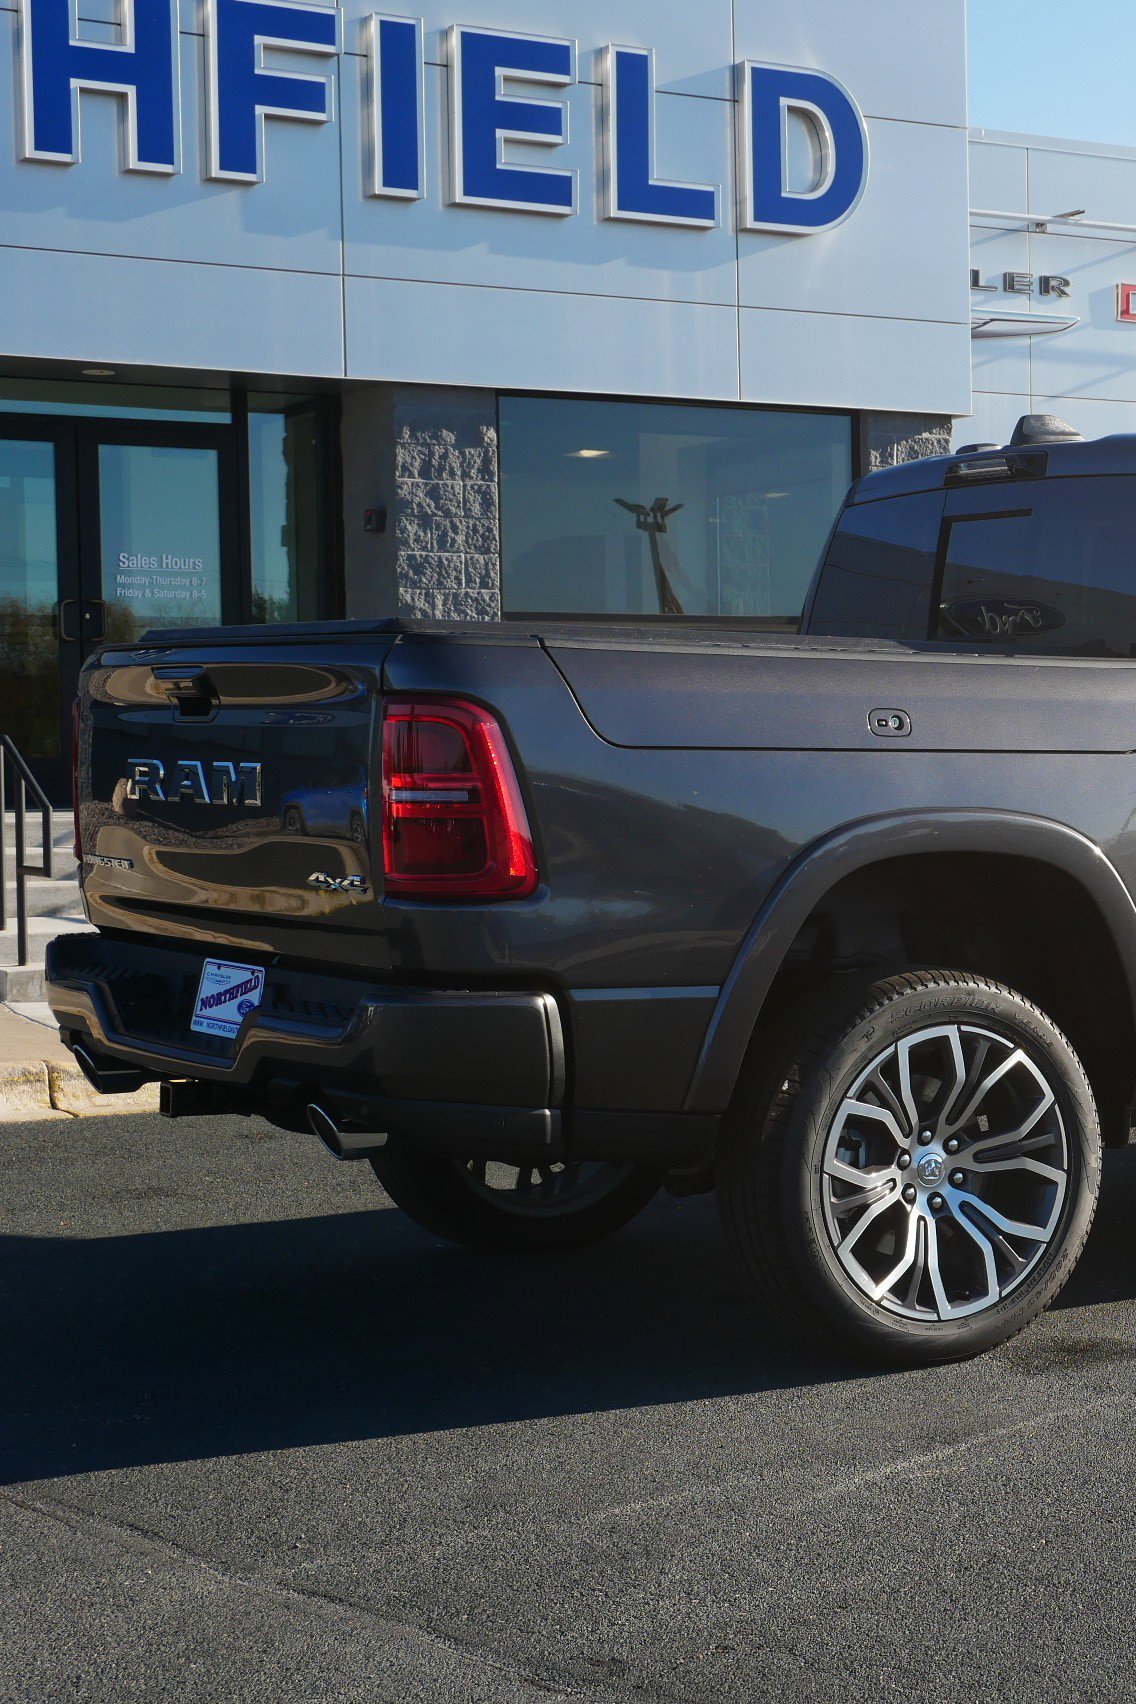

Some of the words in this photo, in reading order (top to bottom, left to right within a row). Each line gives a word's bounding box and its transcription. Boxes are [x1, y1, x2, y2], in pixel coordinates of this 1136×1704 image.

[18, 0, 870, 235] HFIELD
[119, 553, 157, 568] Sales
[162, 554, 203, 569] Hours
[116, 575, 190, 586] Monday-Thursday
[116, 587, 142, 599] Friday
[144, 588, 152, 597] &
[153, 588, 190, 600] Saturday
[127, 758, 262, 806] RAM
[199, 974, 260, 1012] NORTHFIELD
[888, 995, 1005, 1025] SCORPION
